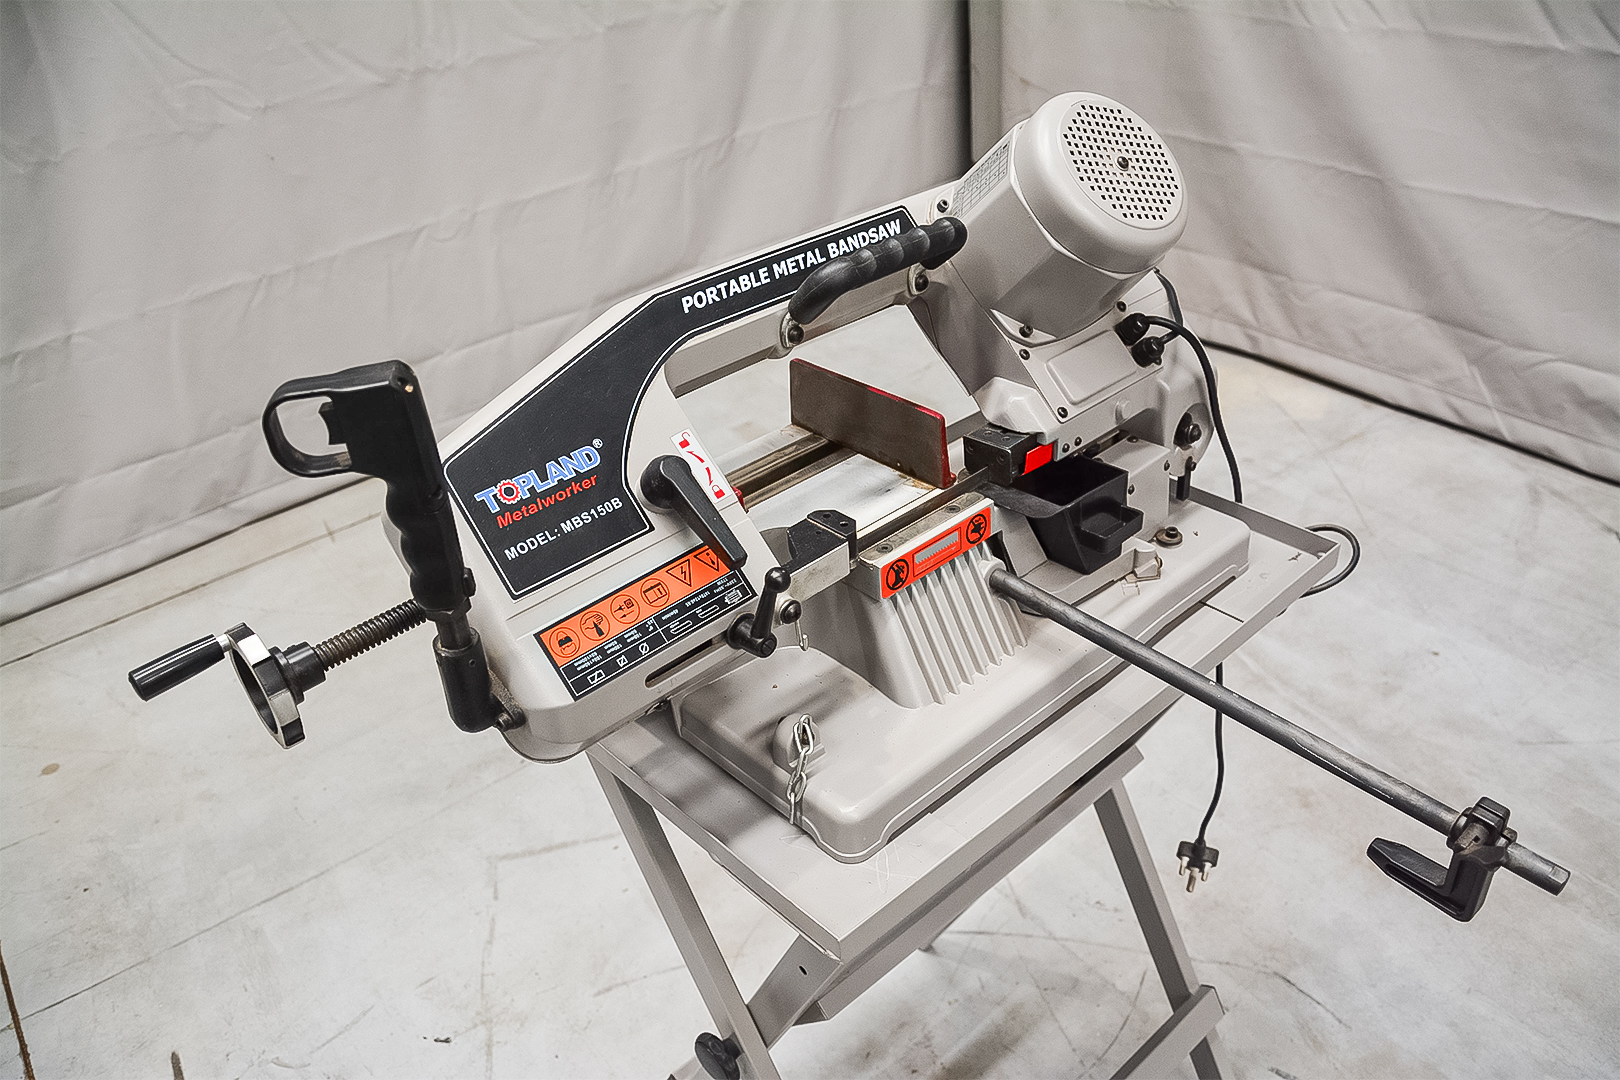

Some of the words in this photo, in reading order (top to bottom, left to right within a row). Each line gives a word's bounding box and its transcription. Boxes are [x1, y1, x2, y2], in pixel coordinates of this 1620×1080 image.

[681, 266, 771, 314] PORTABLE
[772, 247, 827, 280] METAL
[826, 218, 901, 259] BANDSAW
[473, 445, 601, 514] TOPLAND
[496, 474, 598, 529] Metalworker
[503, 528, 561, 561] MODEL:
[559, 497, 623, 534] MBS150B
